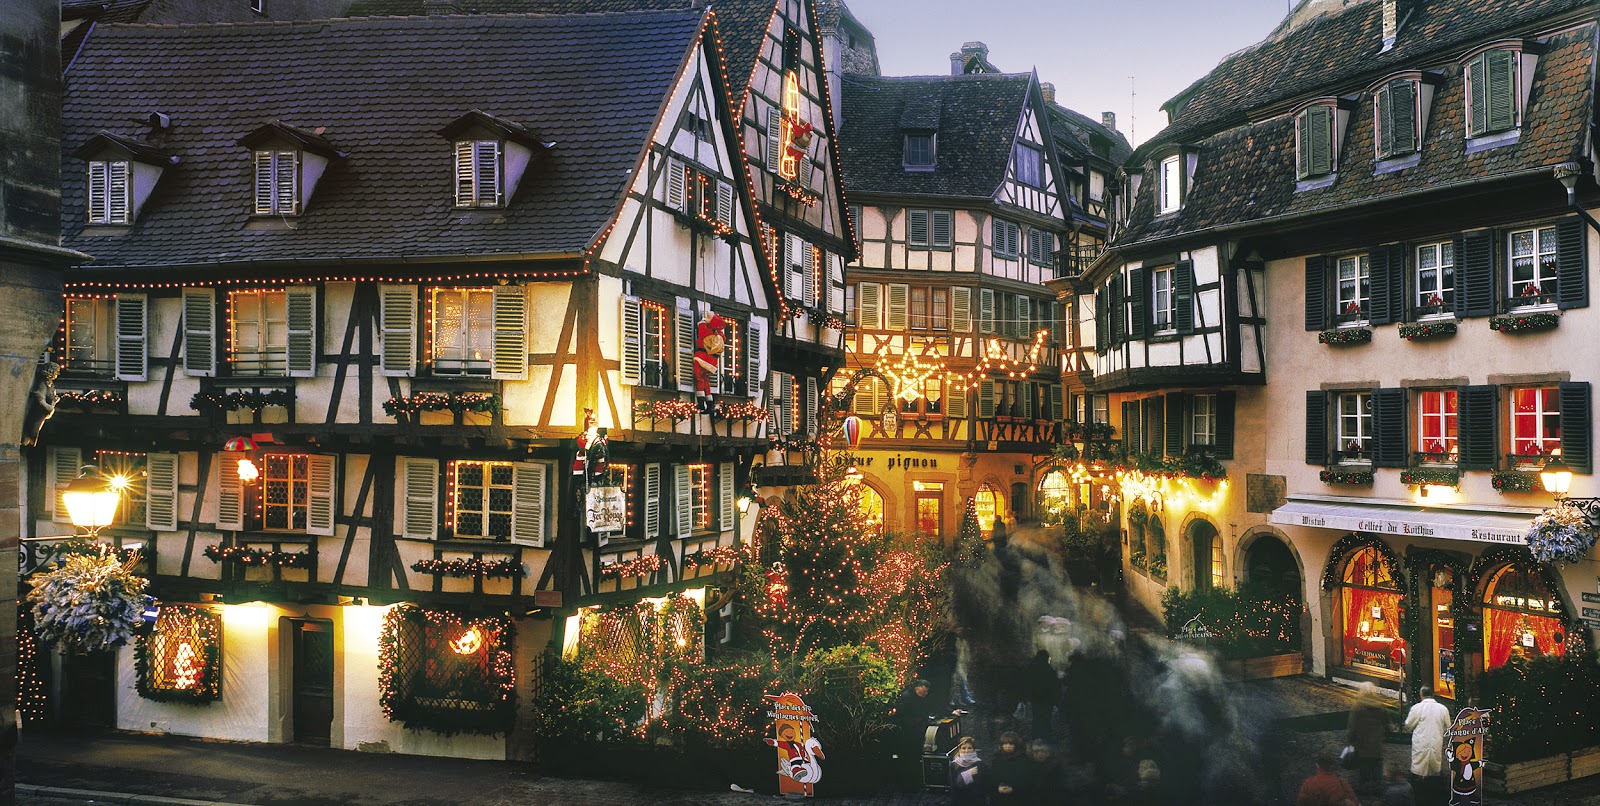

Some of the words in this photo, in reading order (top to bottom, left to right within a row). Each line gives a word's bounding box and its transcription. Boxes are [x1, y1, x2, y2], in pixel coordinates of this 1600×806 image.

[888, 454, 937, 470] pignon
[1302, 516, 1326, 526] Wistub
[1358, 521, 1383, 532] Cellier
[1387, 522, 1398, 532] du
[1471, 529, 1521, 542] Restaurant
[774, 701, 790, 711] Place
[791, 703, 801, 711] des
